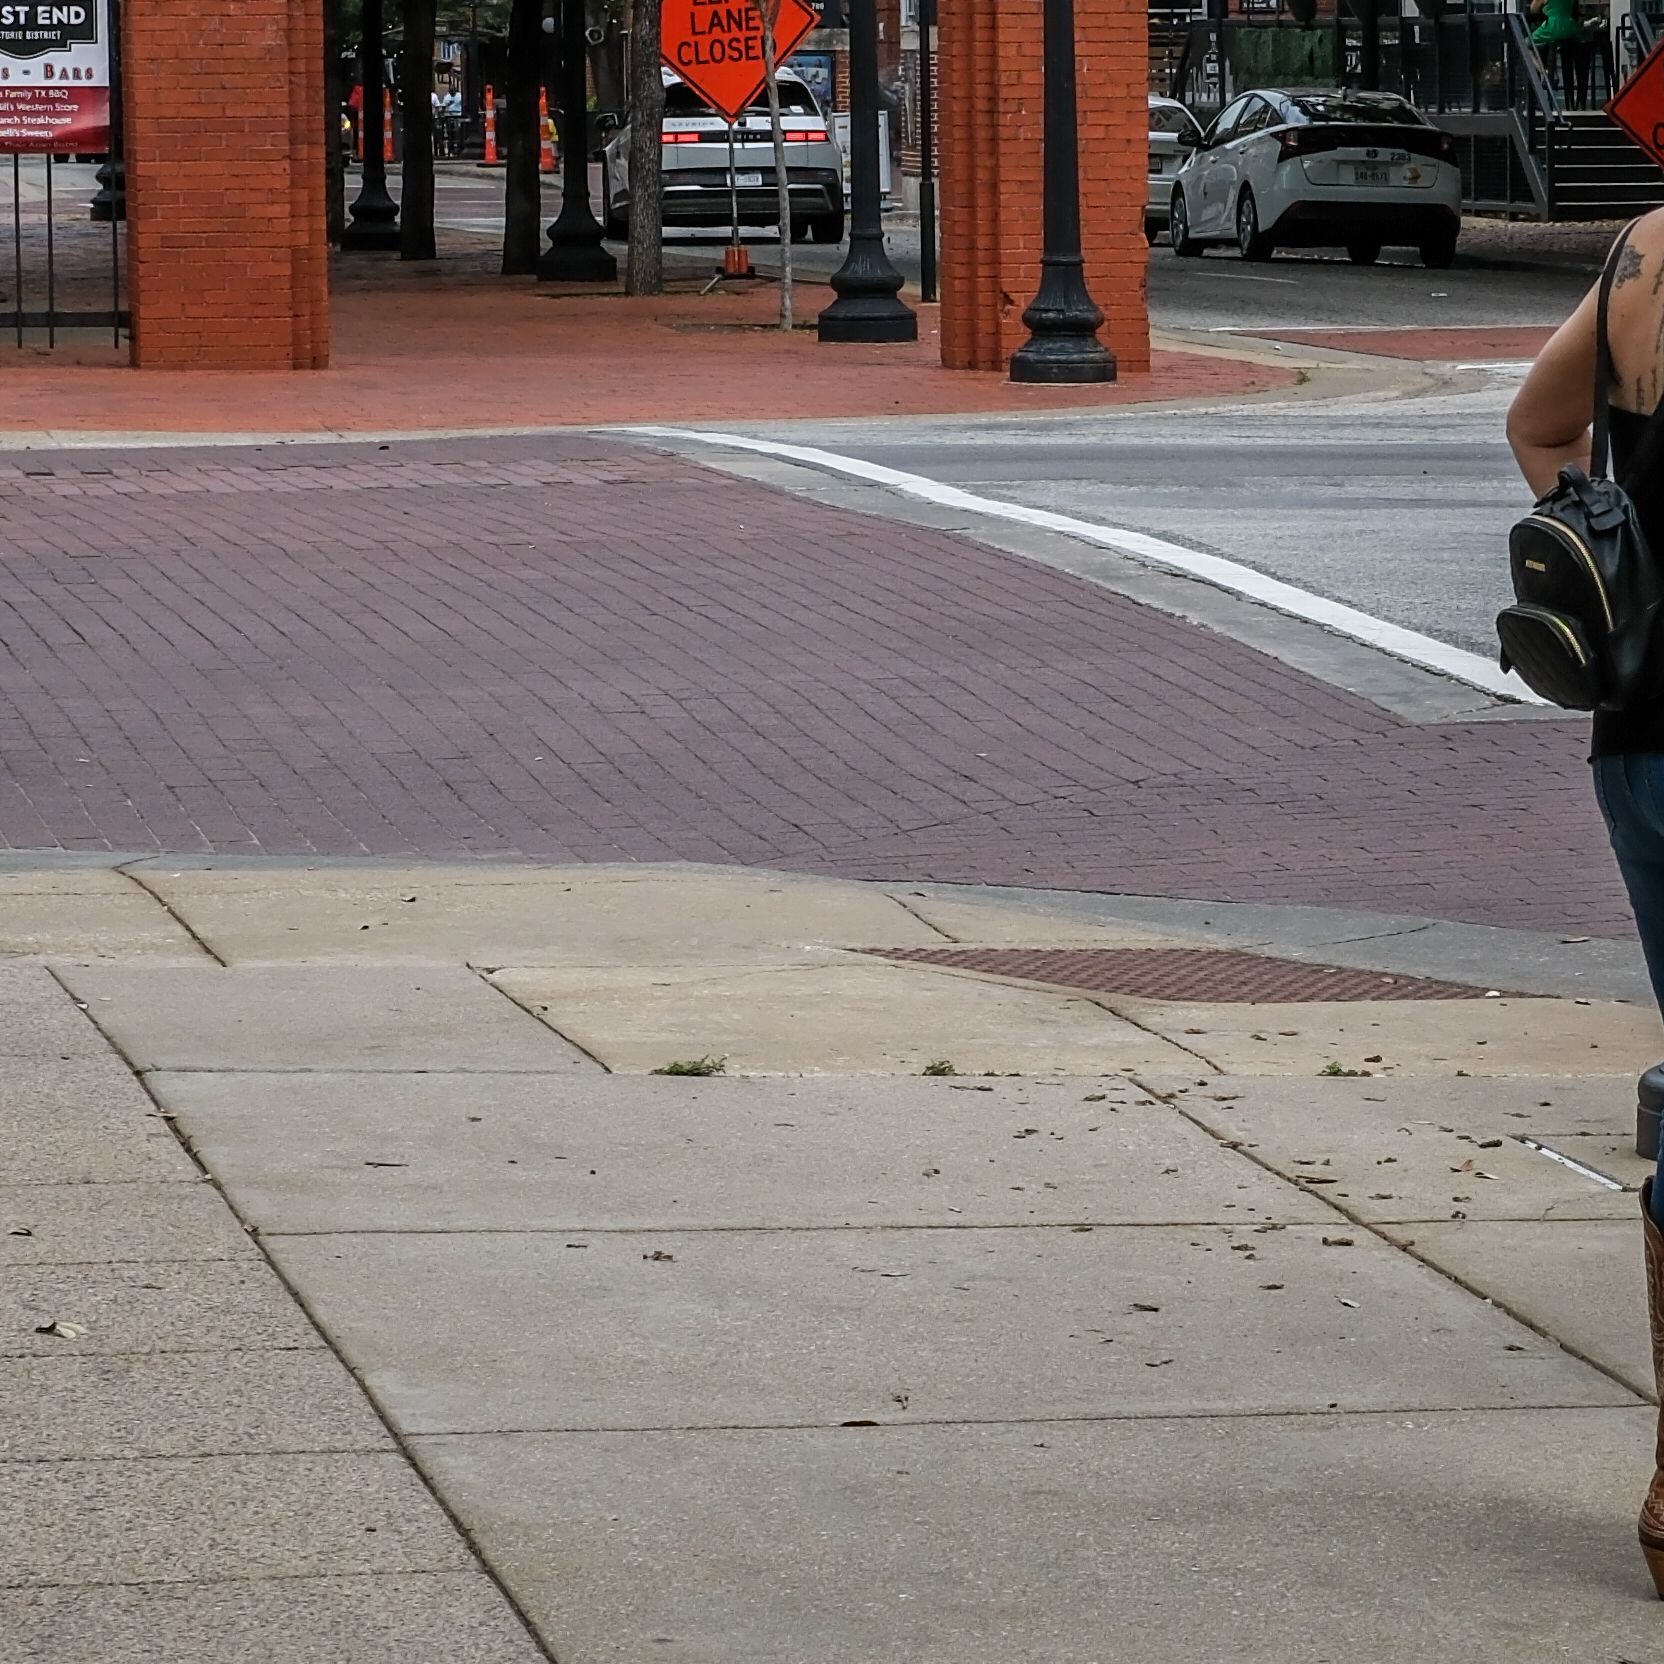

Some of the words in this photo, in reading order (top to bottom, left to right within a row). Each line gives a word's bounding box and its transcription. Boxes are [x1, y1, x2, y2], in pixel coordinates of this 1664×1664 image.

[0, 5, 30, 25] ST
[37, 5, 86, 26] END
[690, 7, 761, 36] LANE
[26, 30, 61, 40] DISTRICT
[5, 89, 33, 101] Family
[35, 89, 47, 98] TX
[22, 116, 72, 125] Steakhouse
